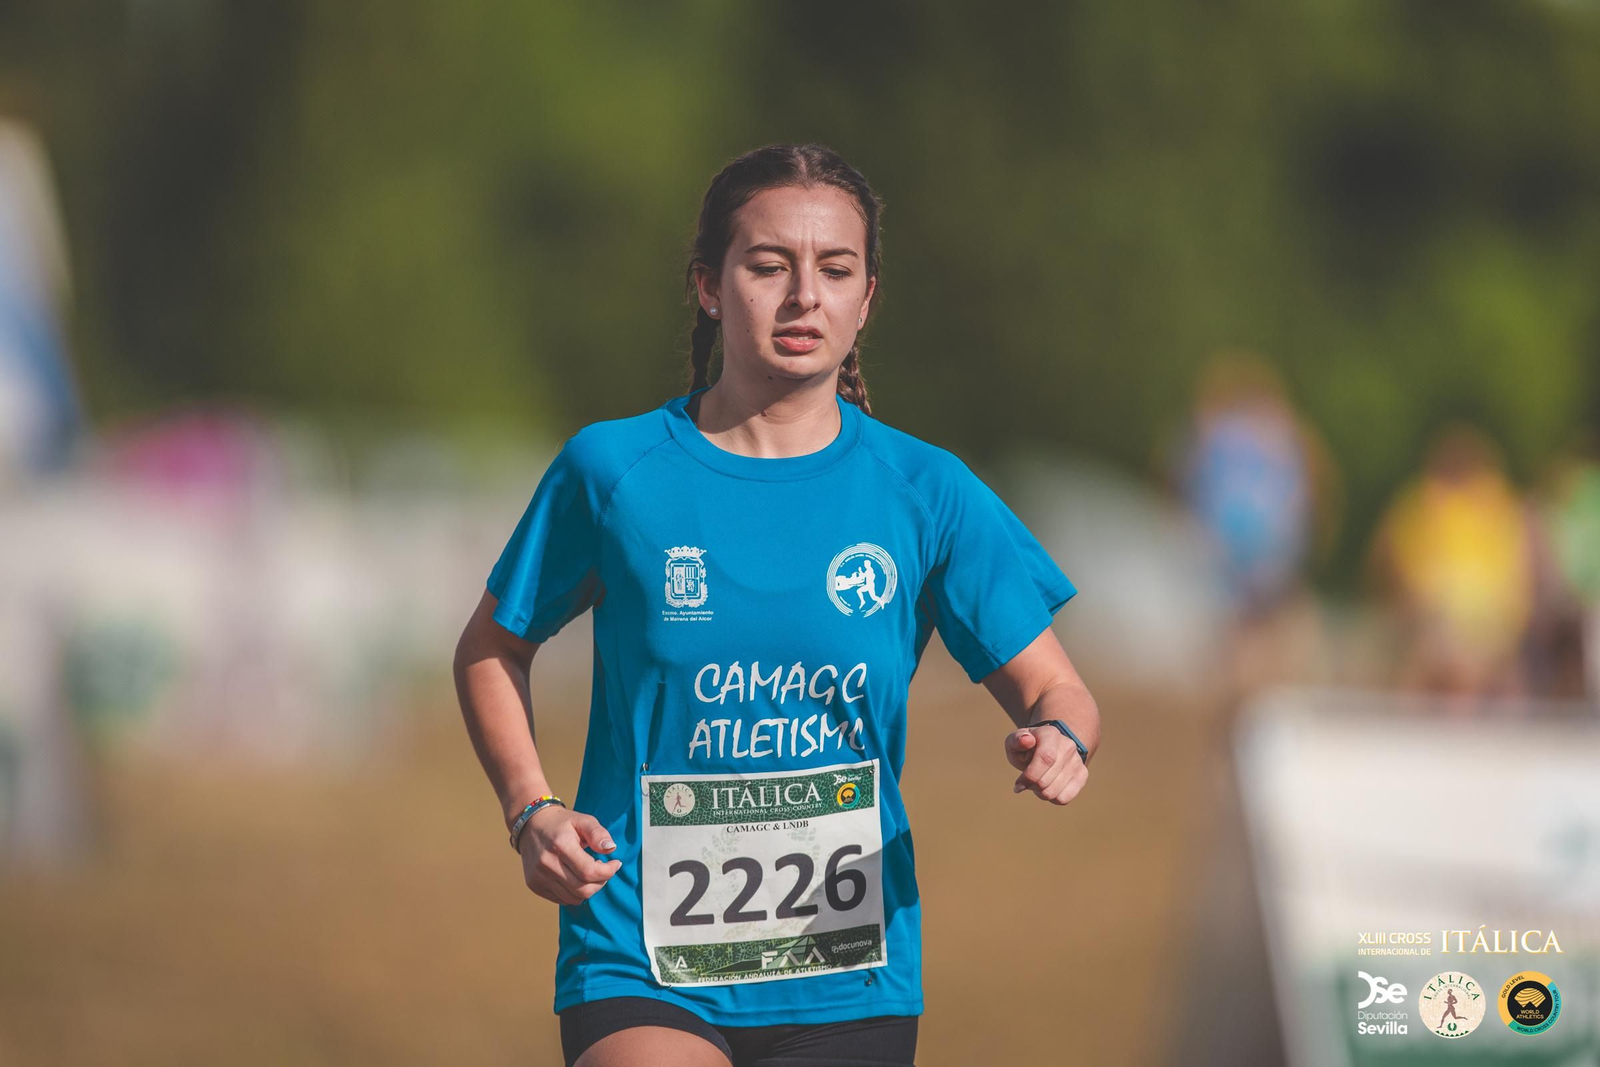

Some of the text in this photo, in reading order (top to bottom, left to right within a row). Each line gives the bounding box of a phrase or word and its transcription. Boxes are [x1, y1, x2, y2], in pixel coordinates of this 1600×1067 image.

[694, 661, 867, 705] CAMAGC
[711, 781, 822, 810] ITÁLICA
[792, 803, 822, 811] COUNTRY
[726, 820, 809, 833] CAMAGC & LNDB
[669, 844, 867, 926] 2226
[838, 939, 873, 950] docunova
